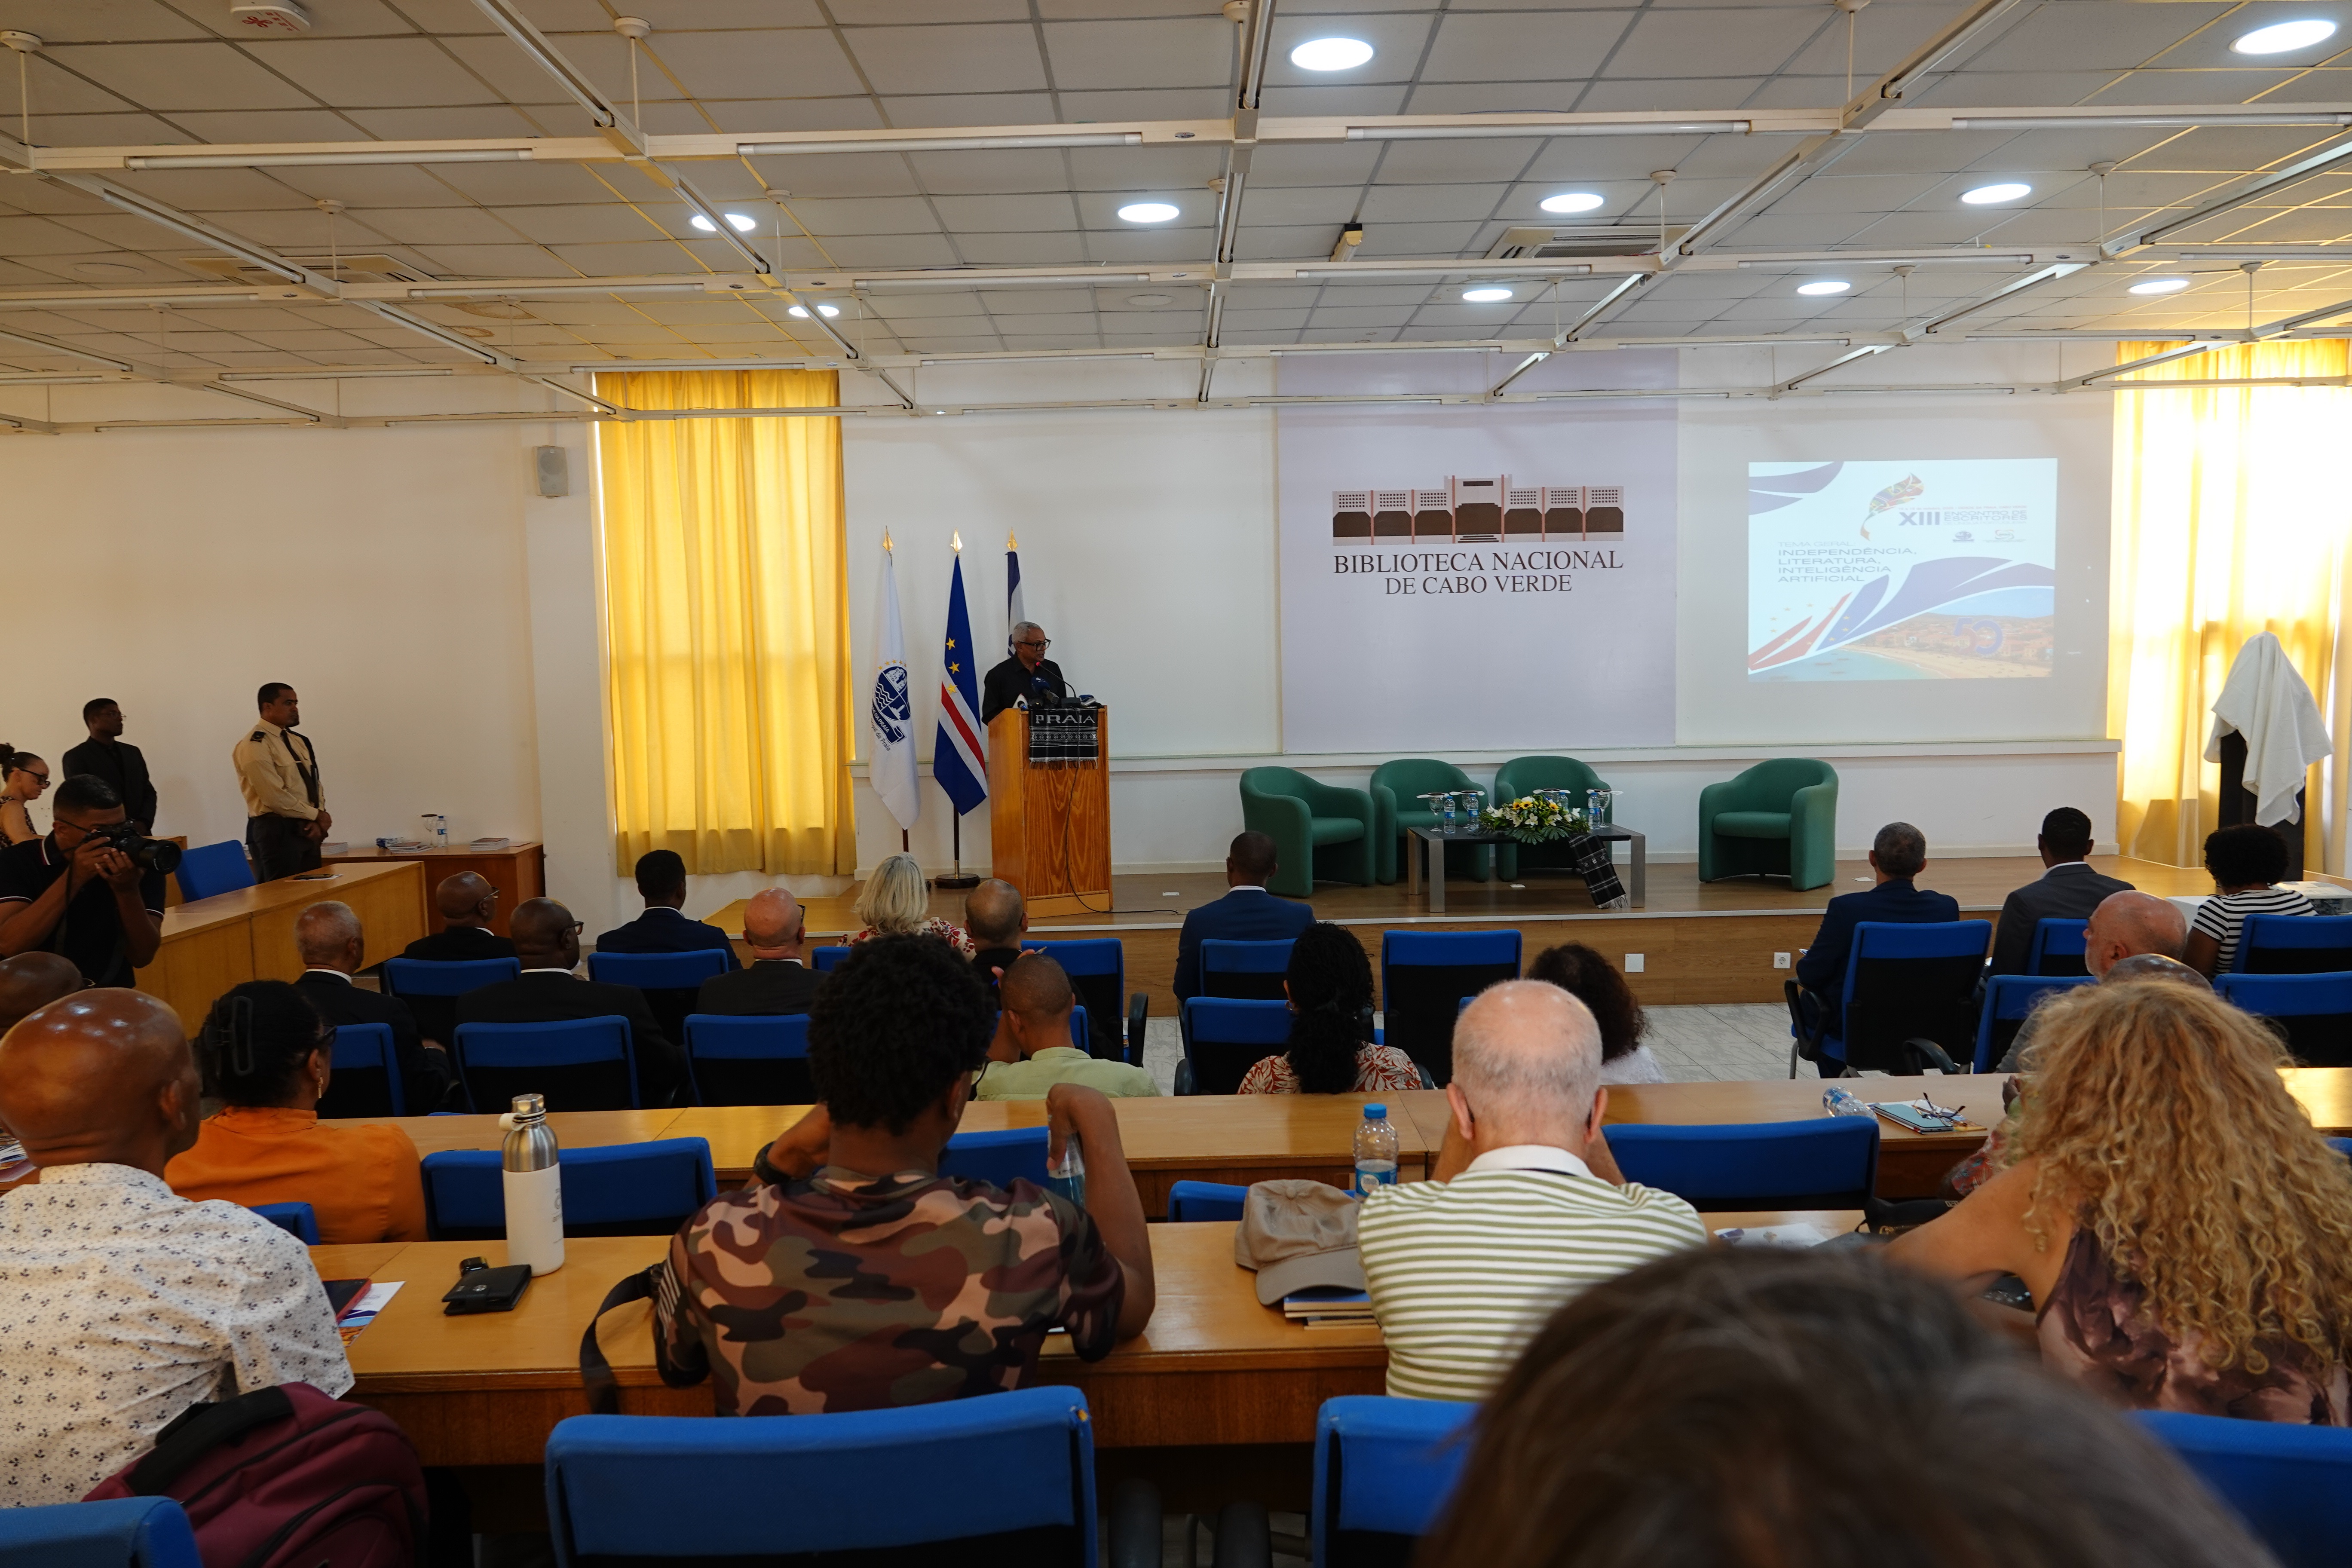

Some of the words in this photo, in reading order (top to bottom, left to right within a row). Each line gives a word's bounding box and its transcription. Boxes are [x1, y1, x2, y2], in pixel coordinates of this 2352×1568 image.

[1898, 511, 1940, 526] XIII
[1778, 547, 1917, 556] INDEPENDÊNCIA,
[1333, 553, 1485, 573] BIBLIOTECA
[1492, 551, 1623, 570] NACIONAL
[1778, 565, 1891, 574] INTELIGÊNCIA
[1385, 578, 1415, 594] DE
[1423, 576, 1487, 594] CABO
[1494, 575, 1572, 592] VERDE
[877, 719, 889, 733] PRAIA
[1035, 715, 1095, 724] PRAIA
[880, 738, 891, 751] Praia
